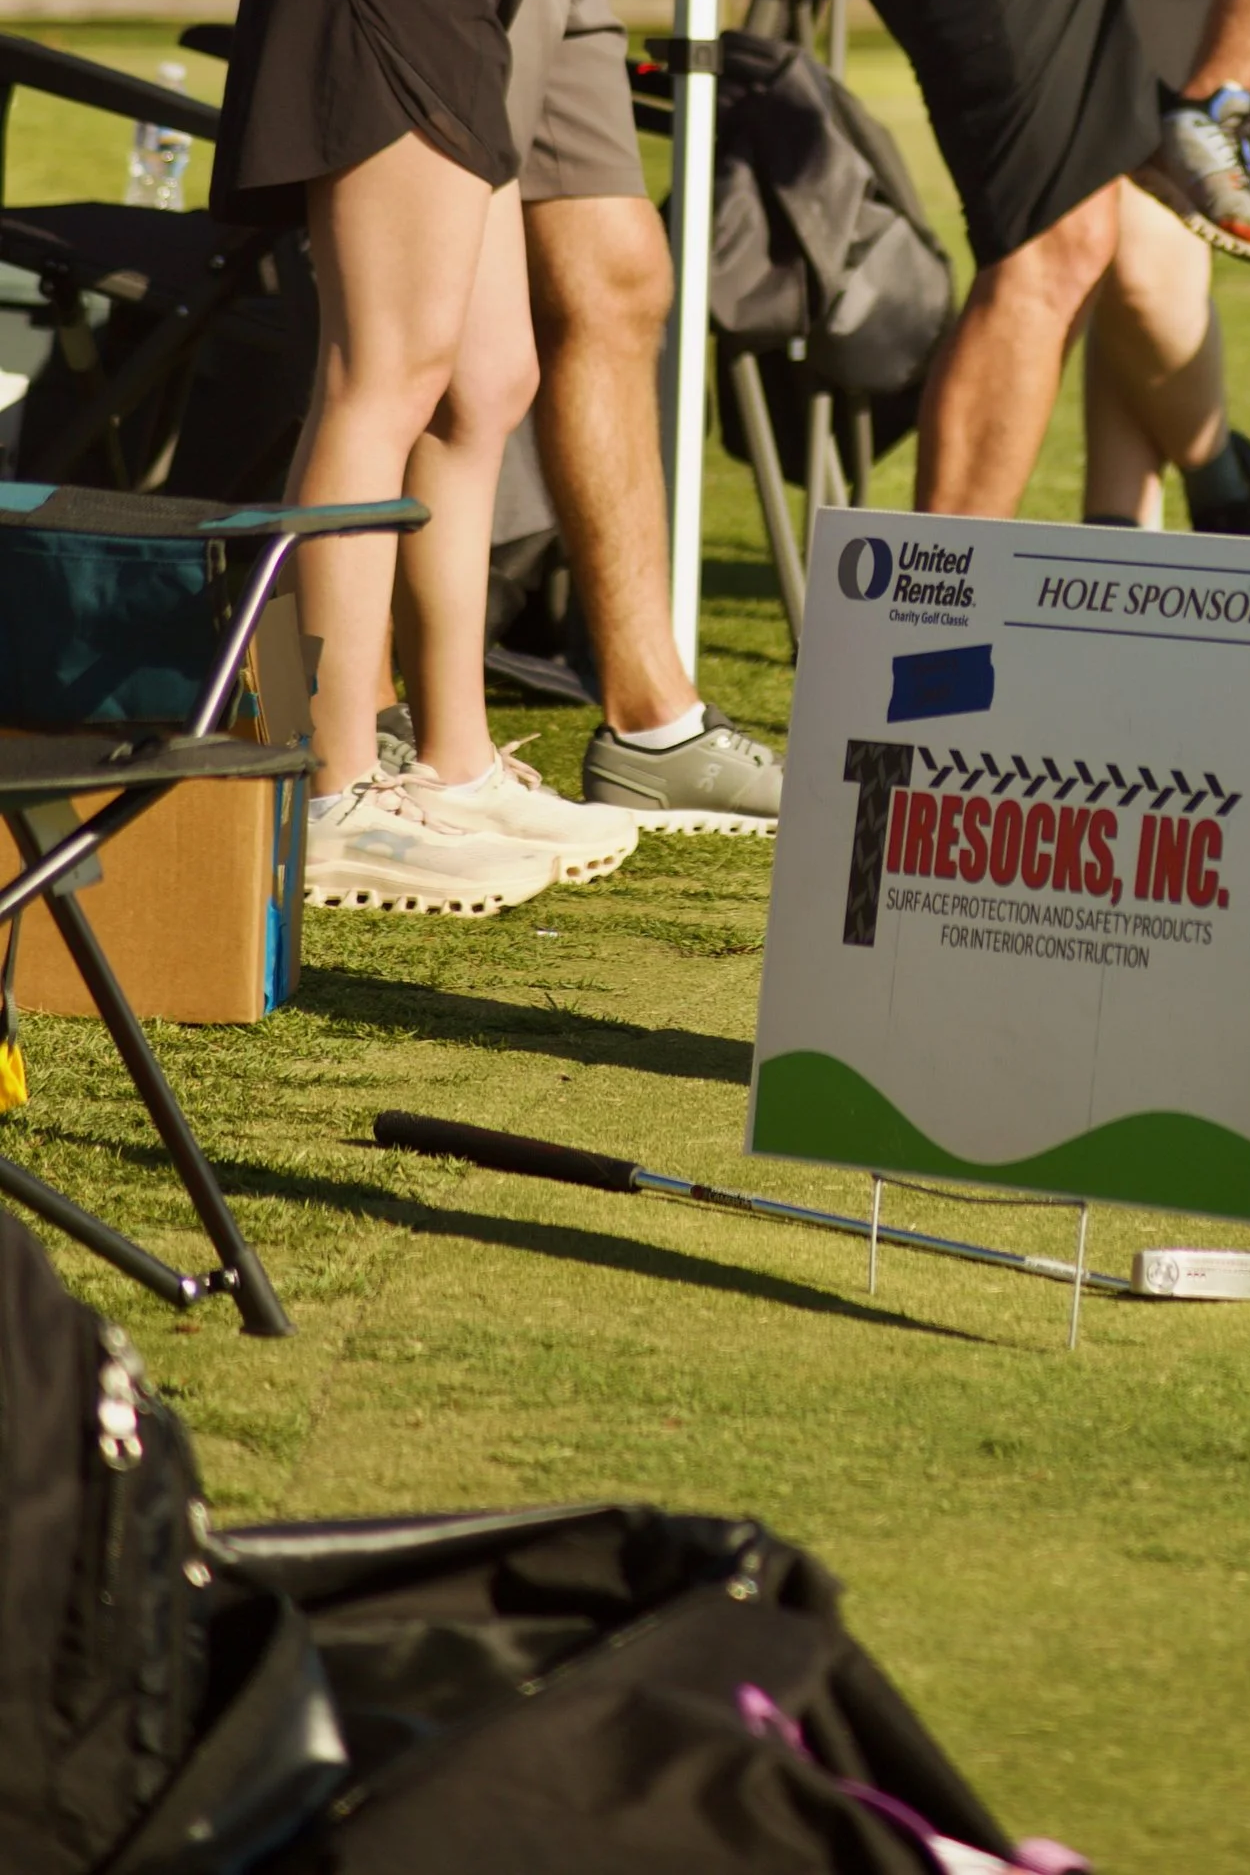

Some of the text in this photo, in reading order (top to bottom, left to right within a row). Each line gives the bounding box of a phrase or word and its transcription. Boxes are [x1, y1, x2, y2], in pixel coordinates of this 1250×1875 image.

[898, 541, 974, 575] United
[1038, 577, 1120, 612] HOLE
[889, 609, 969, 627] Charity Golf Classic
[1134, 813, 1230, 910] INC.
[886, 887, 1213, 946] SURFACE PROTECTION AND SAFETY PRODUCTS
[941, 924, 1150, 969] FOR INTERIOR CONSTRUCTION
